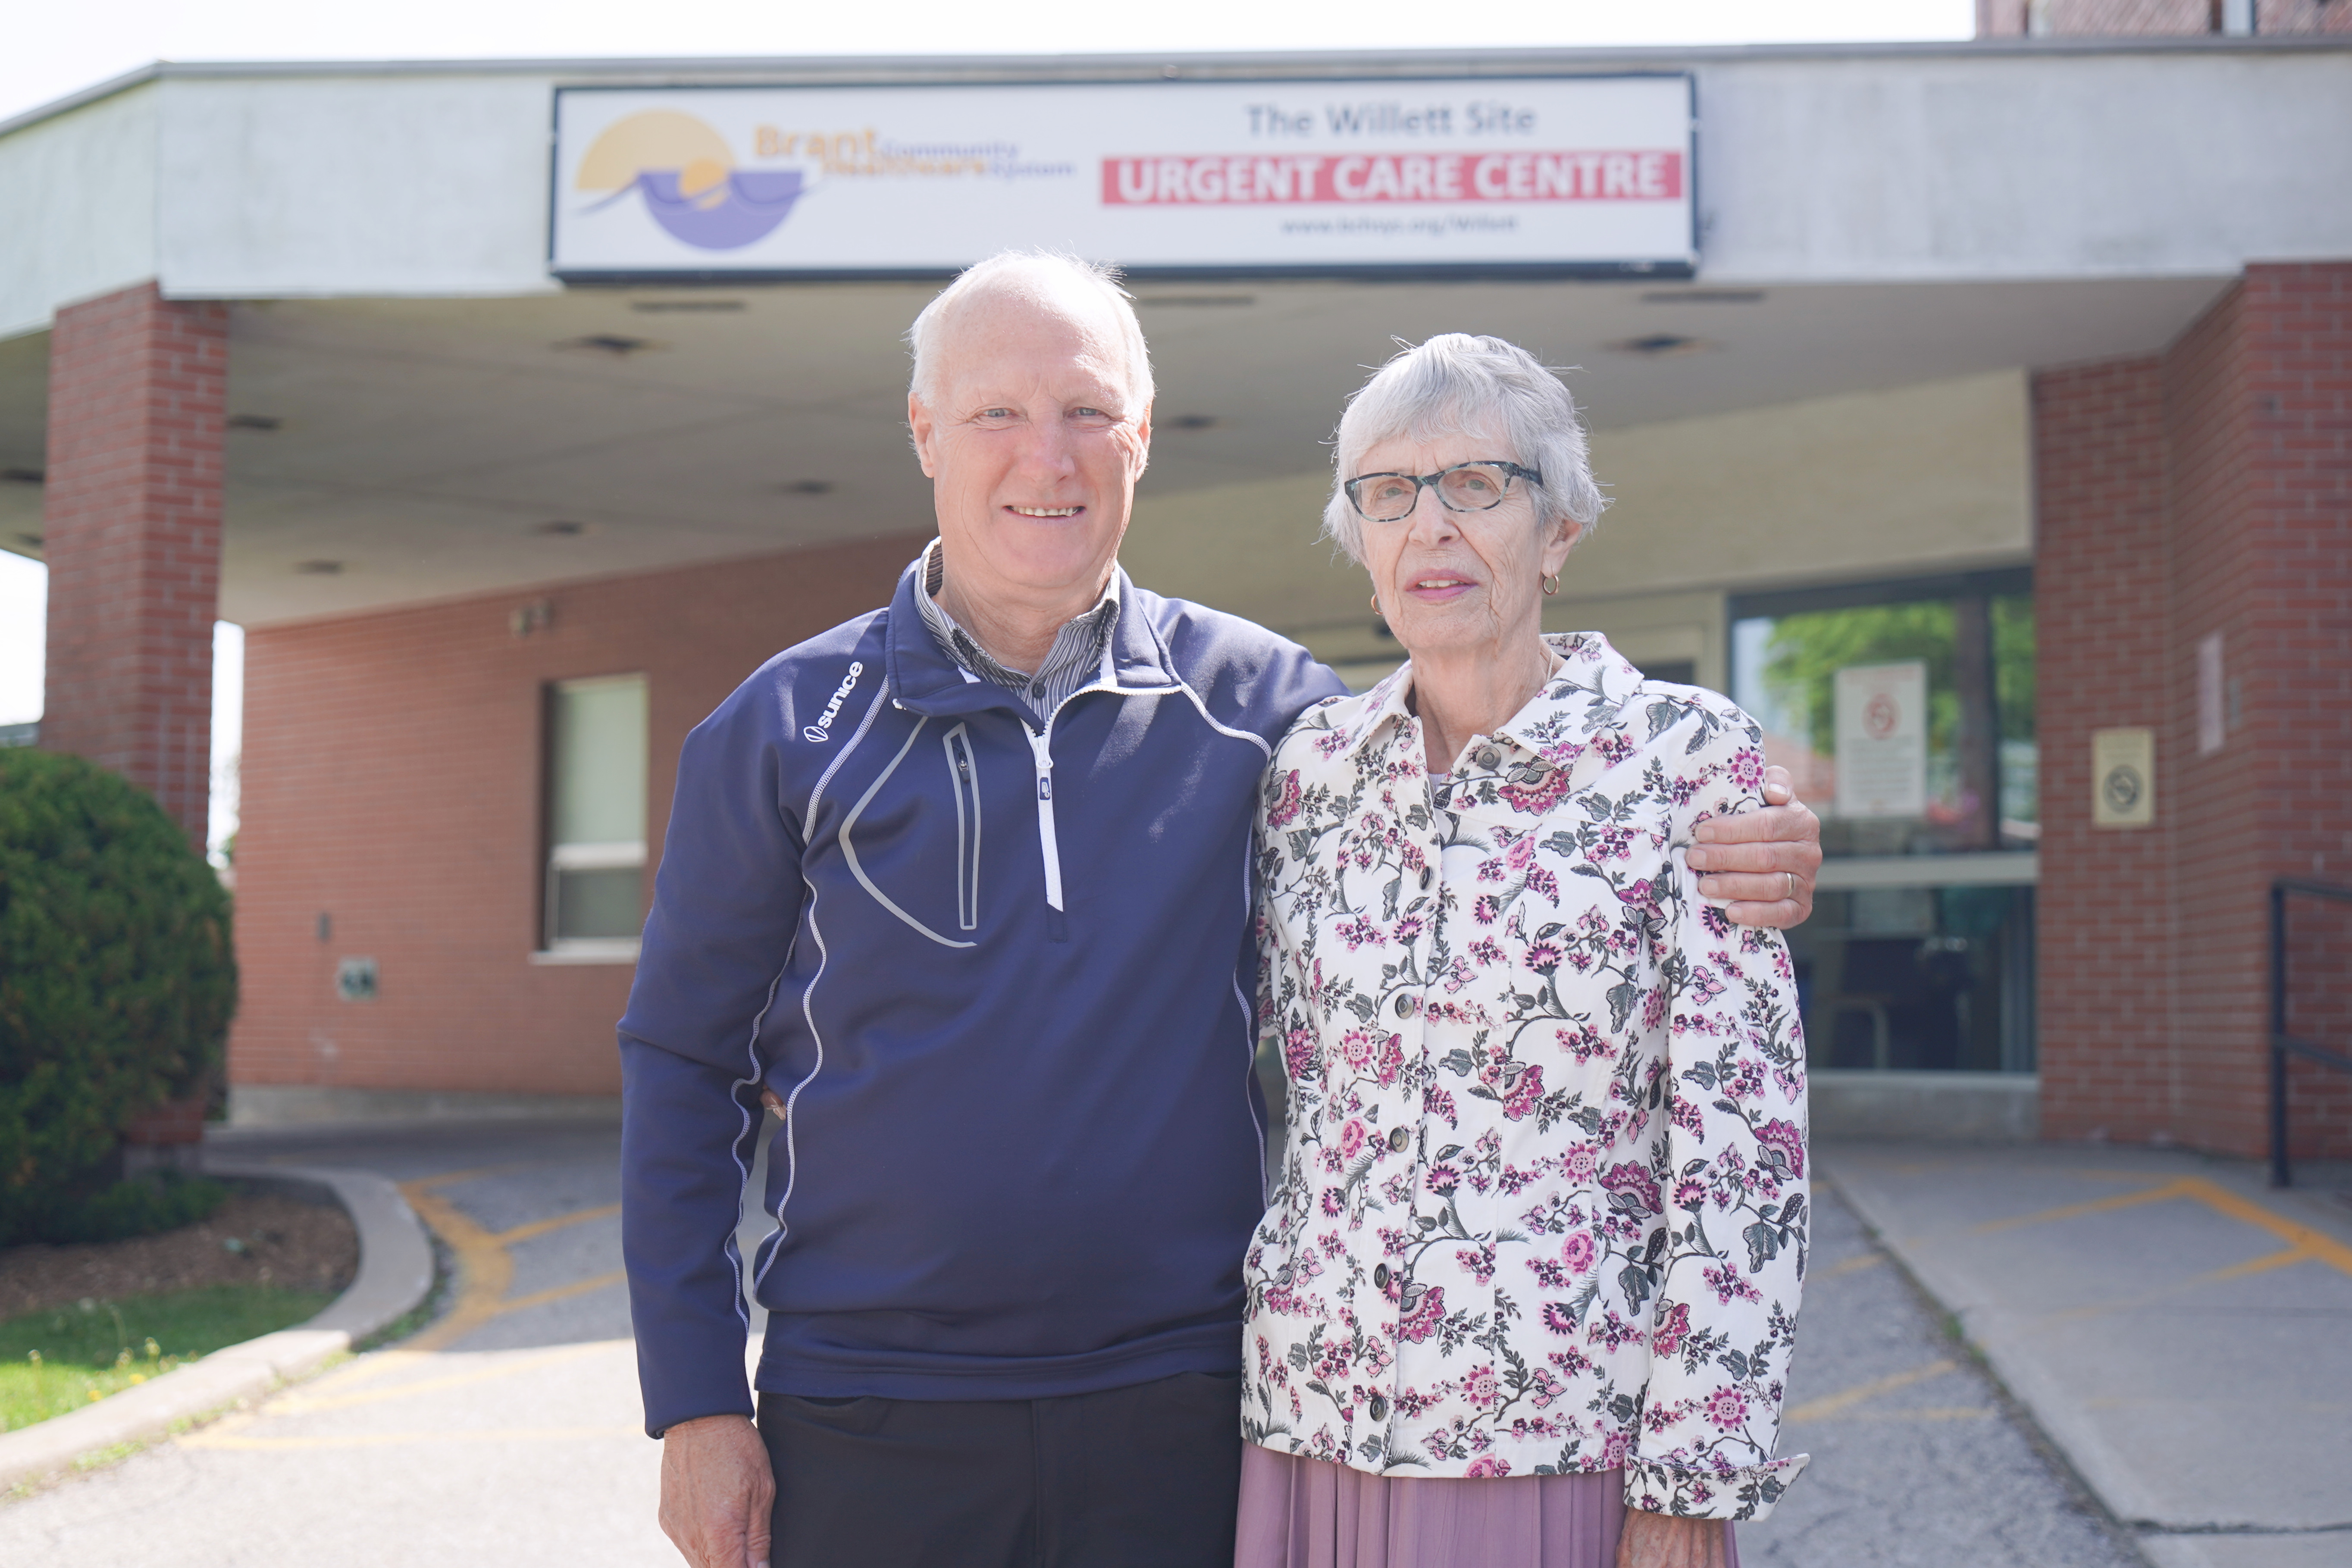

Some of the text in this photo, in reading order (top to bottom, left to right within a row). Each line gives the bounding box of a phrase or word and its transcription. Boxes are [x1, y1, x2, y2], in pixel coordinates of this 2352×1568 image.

[1248, 100, 1536, 136] The Willett Site
[754, 125, 877, 158] Brant
[880, 139, 1019, 159] Community
[1118, 153, 1666, 202] URGENT CARE CENTRE
[817, 661, 863, 729] sunice
